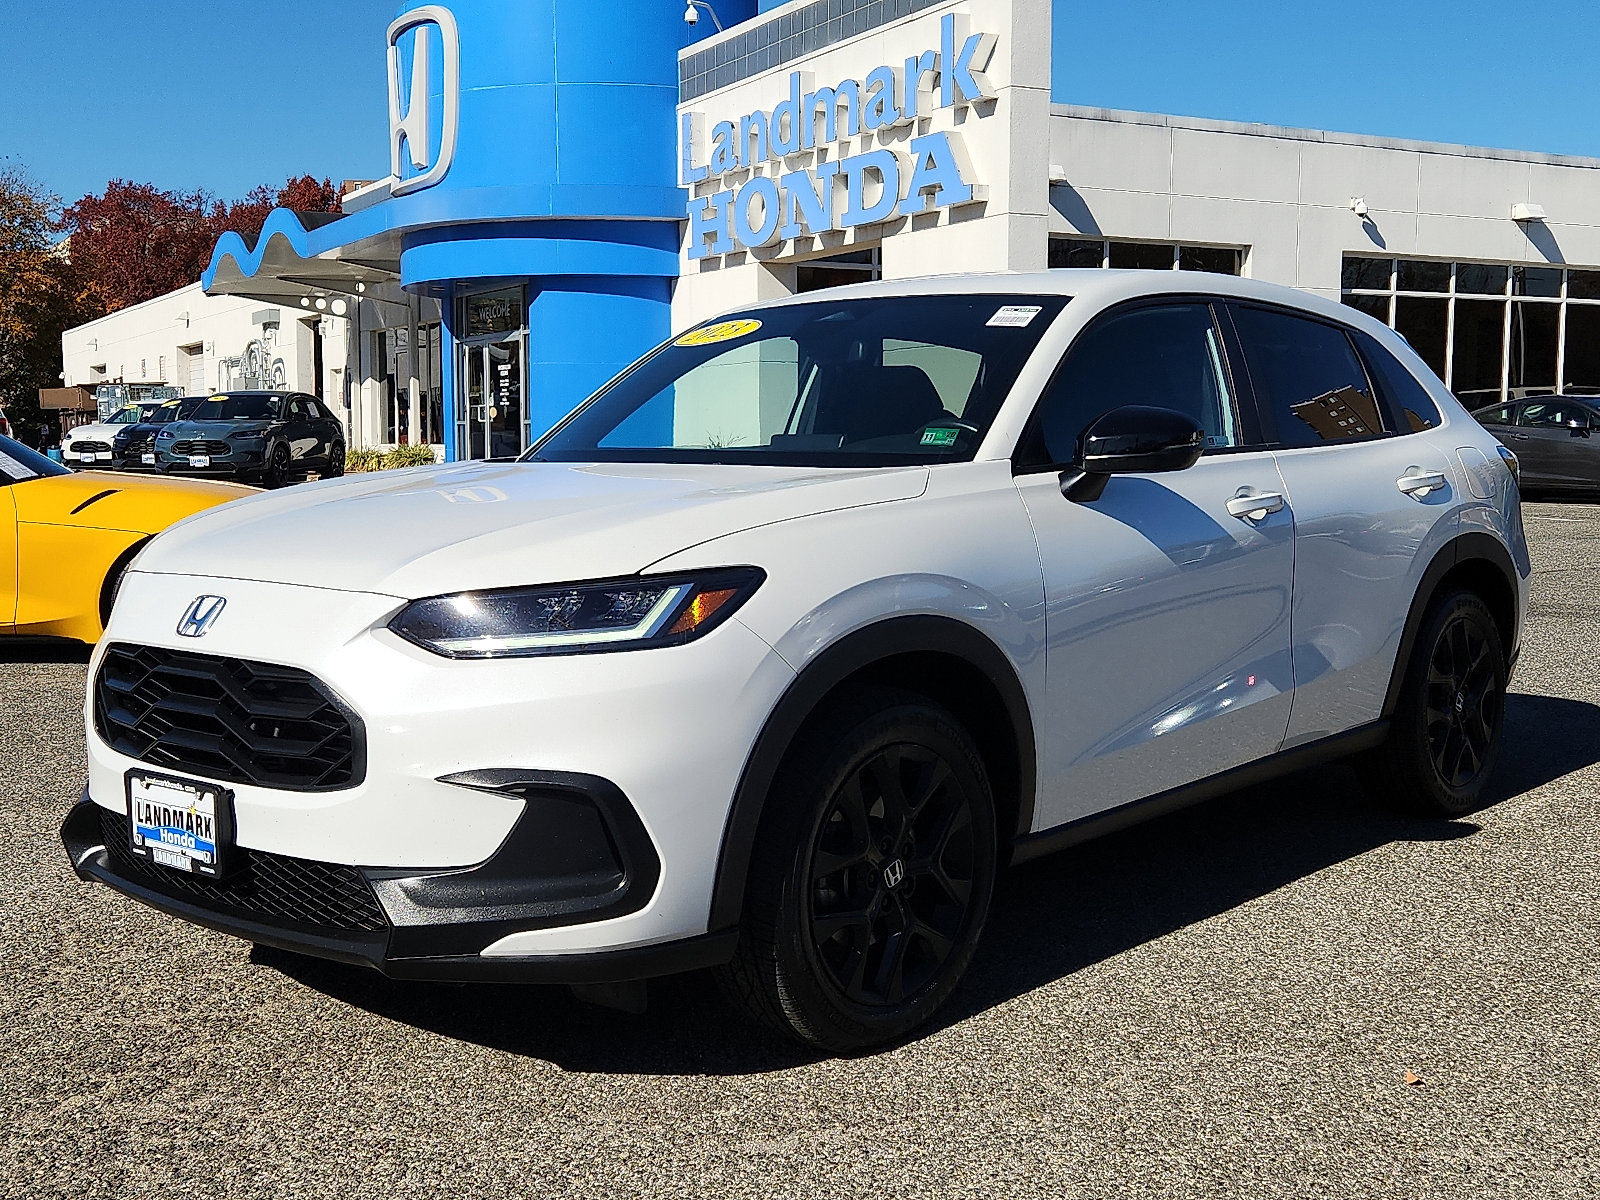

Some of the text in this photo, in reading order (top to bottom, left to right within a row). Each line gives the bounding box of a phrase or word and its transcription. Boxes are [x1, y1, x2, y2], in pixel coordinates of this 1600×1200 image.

[682, 12, 986, 185] Landmark
[686, 130, 974, 260] HONDA
[478, 303, 511, 320] WELCOME
[136, 799, 213, 842] LANDMARK
[160, 828, 196, 849] Honda
